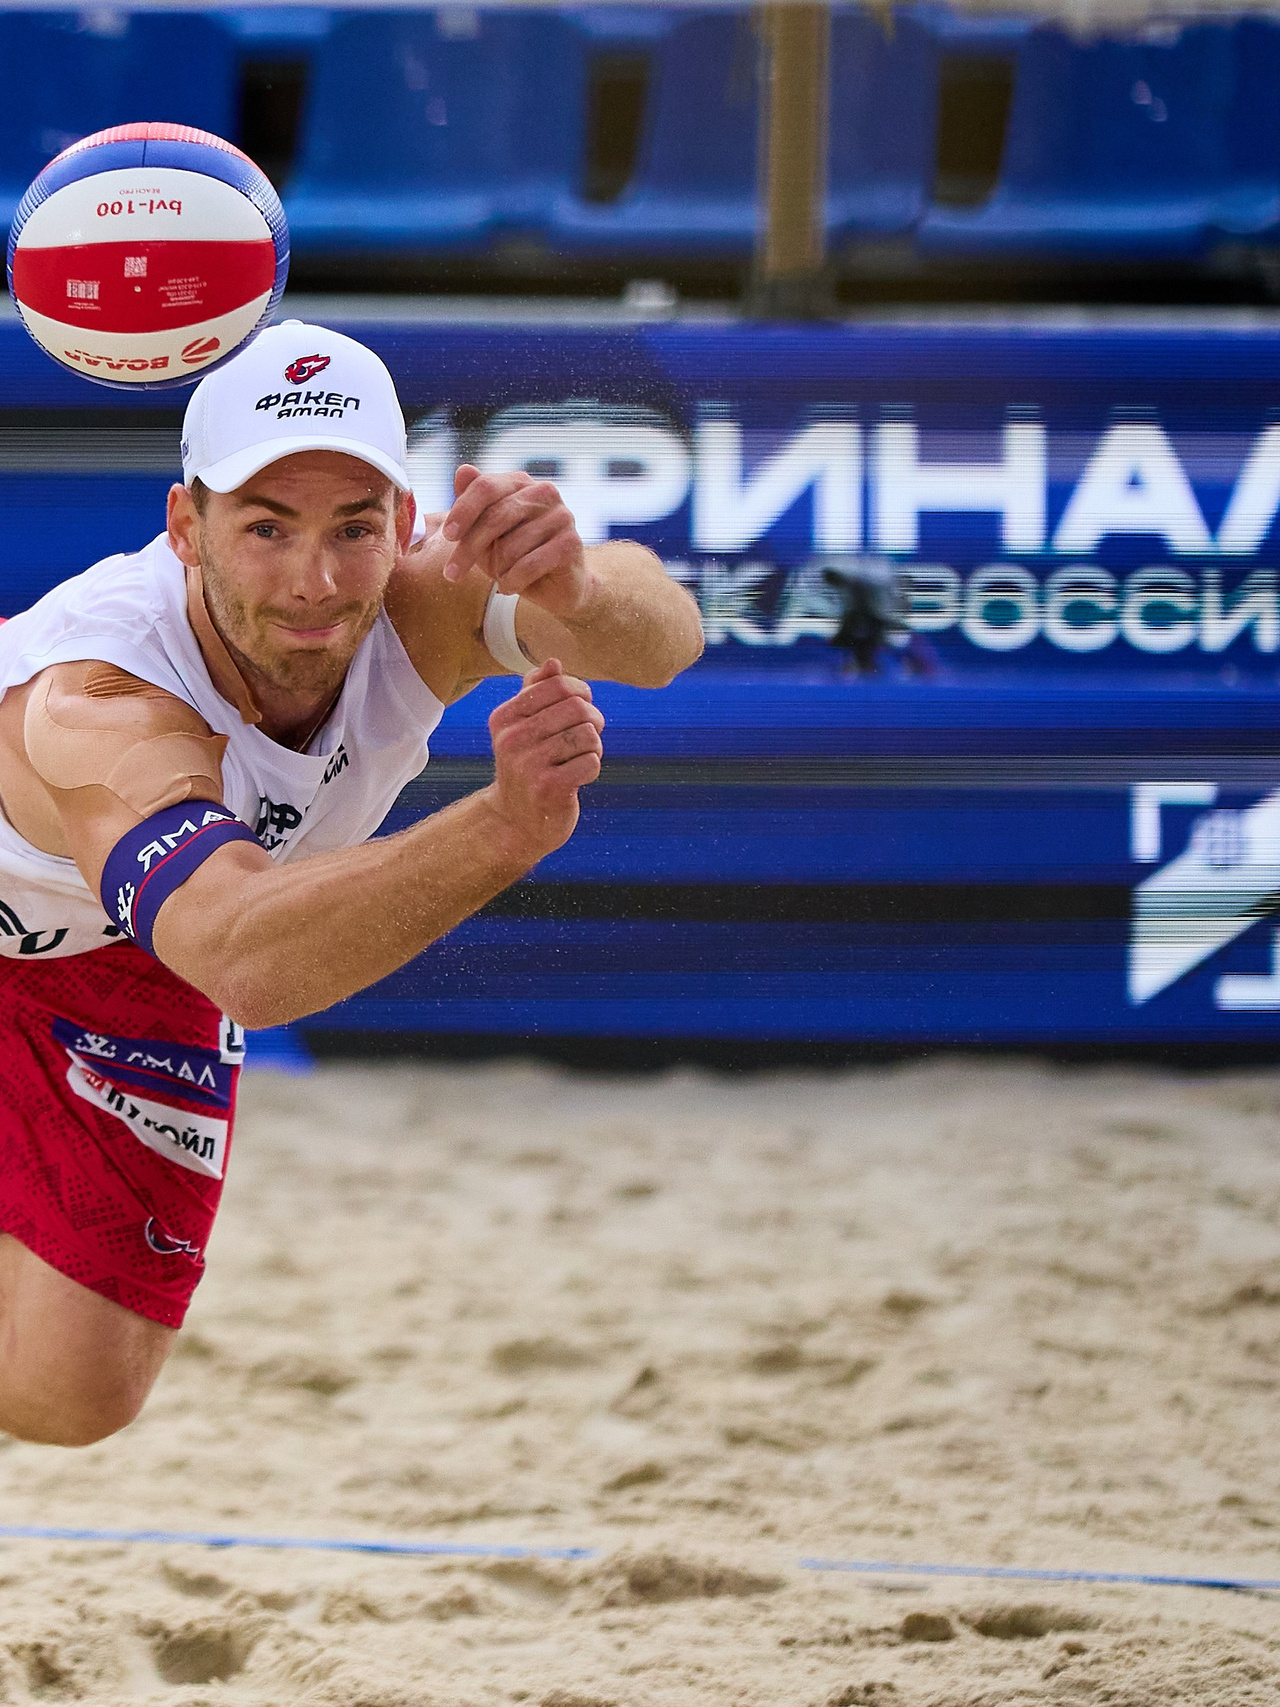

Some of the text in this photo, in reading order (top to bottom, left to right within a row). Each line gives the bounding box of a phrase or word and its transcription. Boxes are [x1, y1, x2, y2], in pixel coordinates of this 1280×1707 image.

[96, 199, 183, 217] bvl-100
[255, 391, 360, 411] ФАКЕЛ
[276, 407, 344, 420] ЯМАЛ
[137, 810, 243, 873] ЯМА
